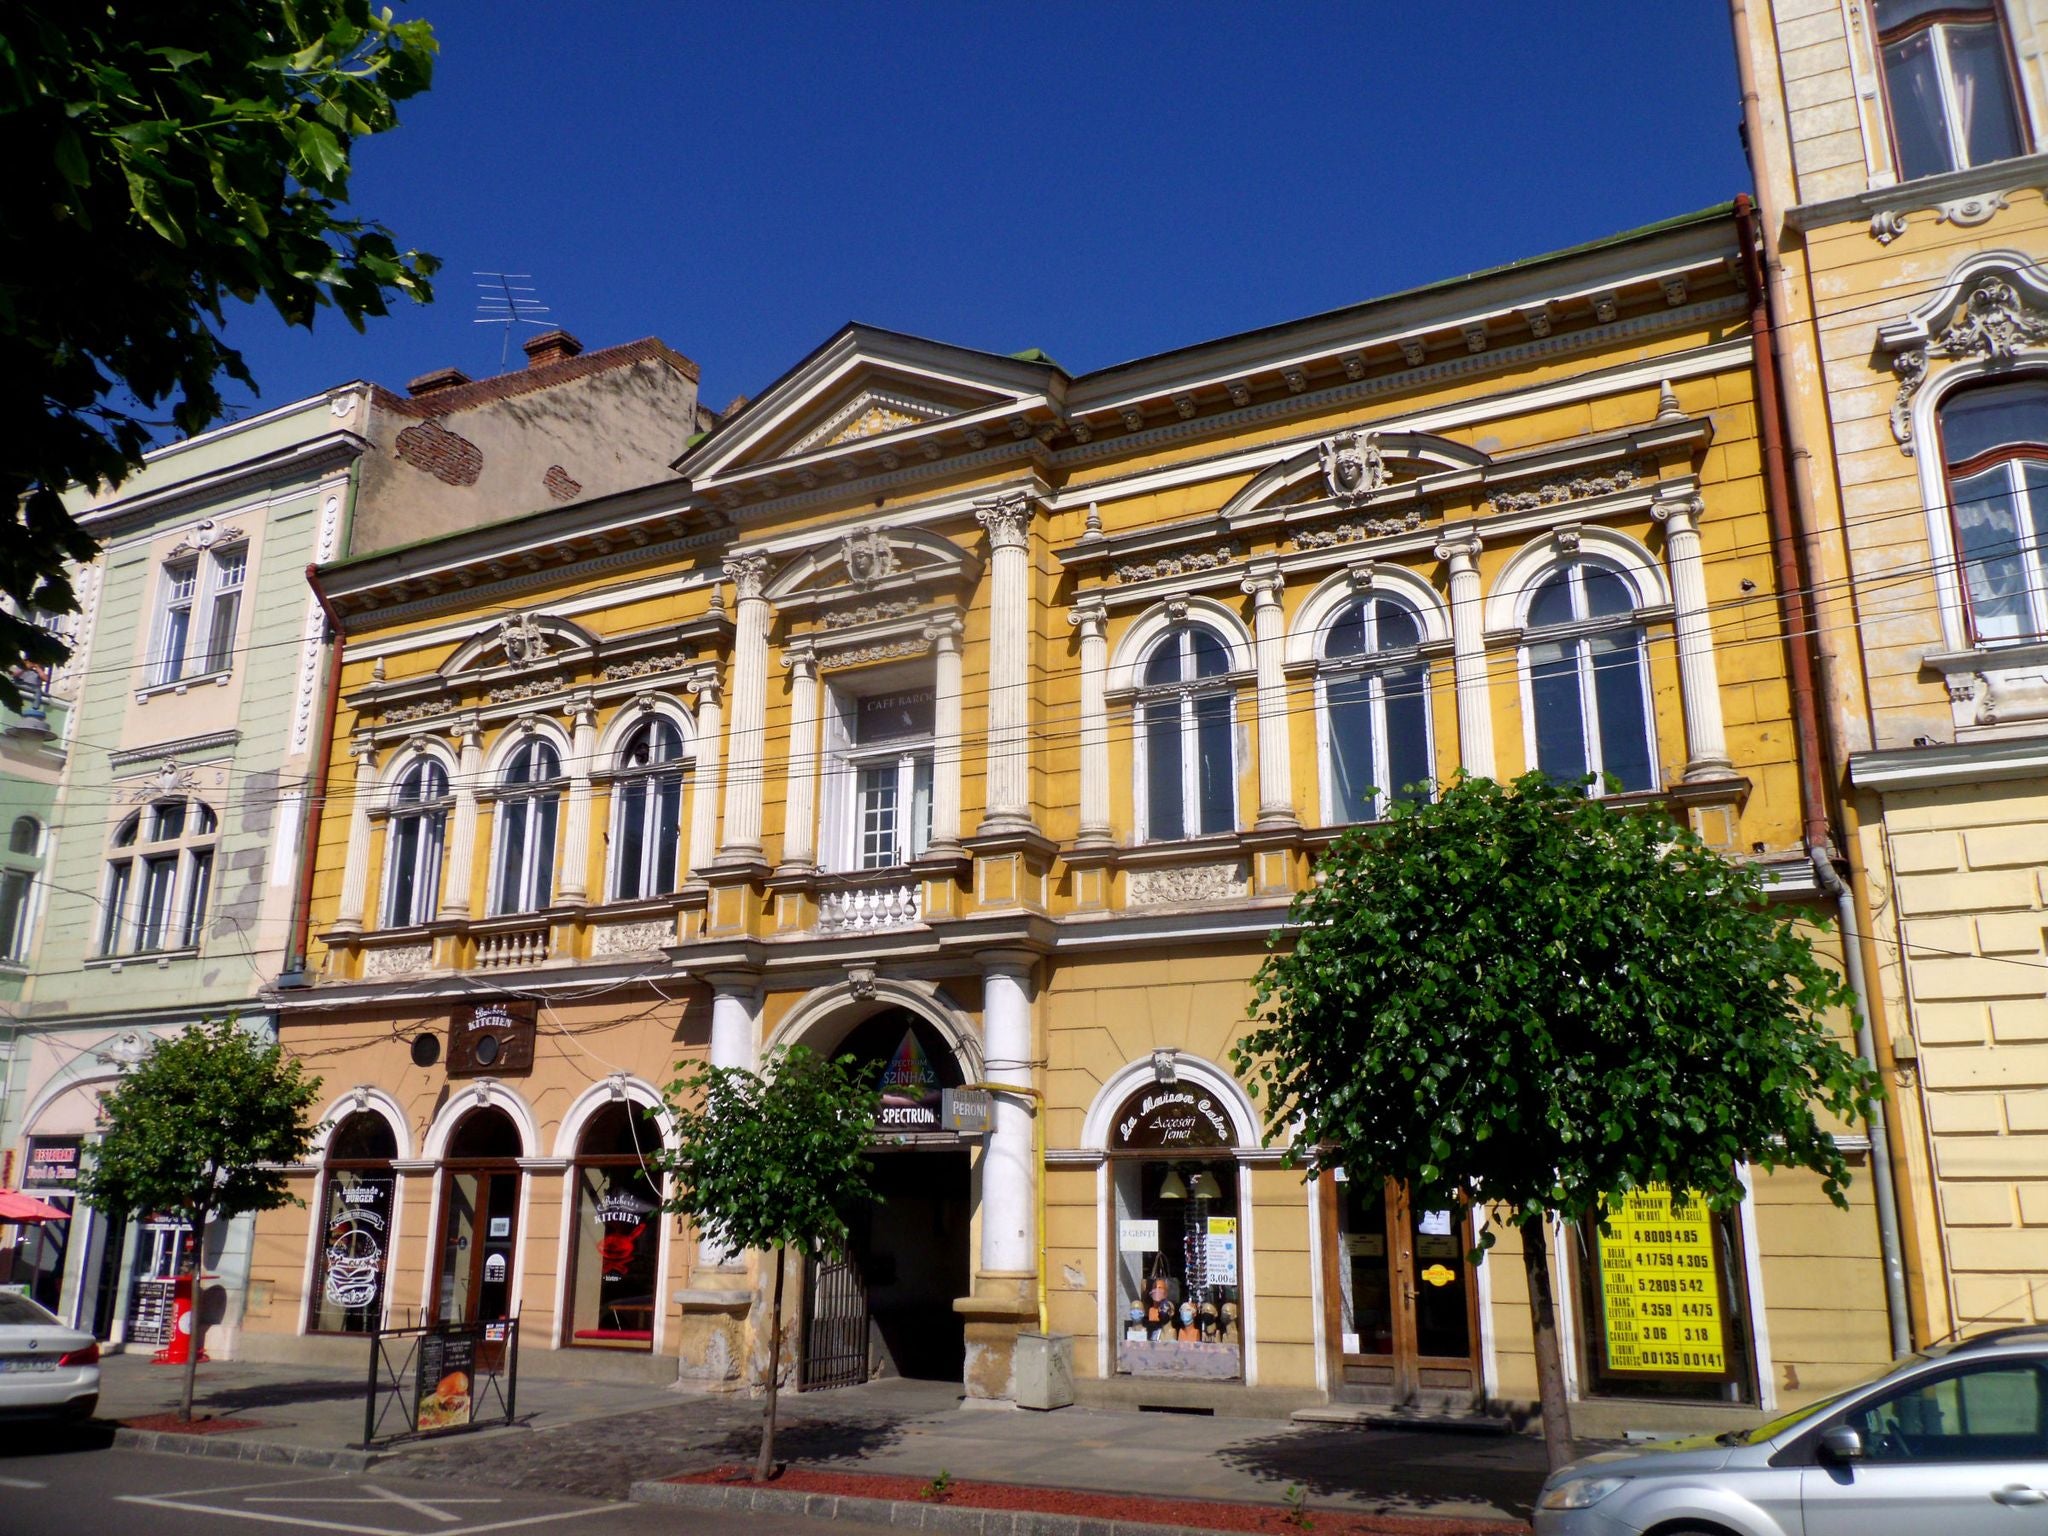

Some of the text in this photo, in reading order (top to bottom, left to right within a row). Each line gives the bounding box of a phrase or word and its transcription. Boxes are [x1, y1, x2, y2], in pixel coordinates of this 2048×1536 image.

[867, 698, 895, 712] CAFE
[468, 1016, 513, 1031] KITCHEN
[882, 1108, 935, 1124] SPECTRUM
[952, 1101, 987, 1117] PERONI
[1120, 1116, 1138, 1141] La
[1140, 1092, 1195, 1116] Maison
[343, 1186, 378, 1195] handmade
[346, 1195, 374, 1203] BURGER
[594, 1211, 641, 1225] KITCHEN
[1603, 1259, 1632, 1269] AMERICAN
